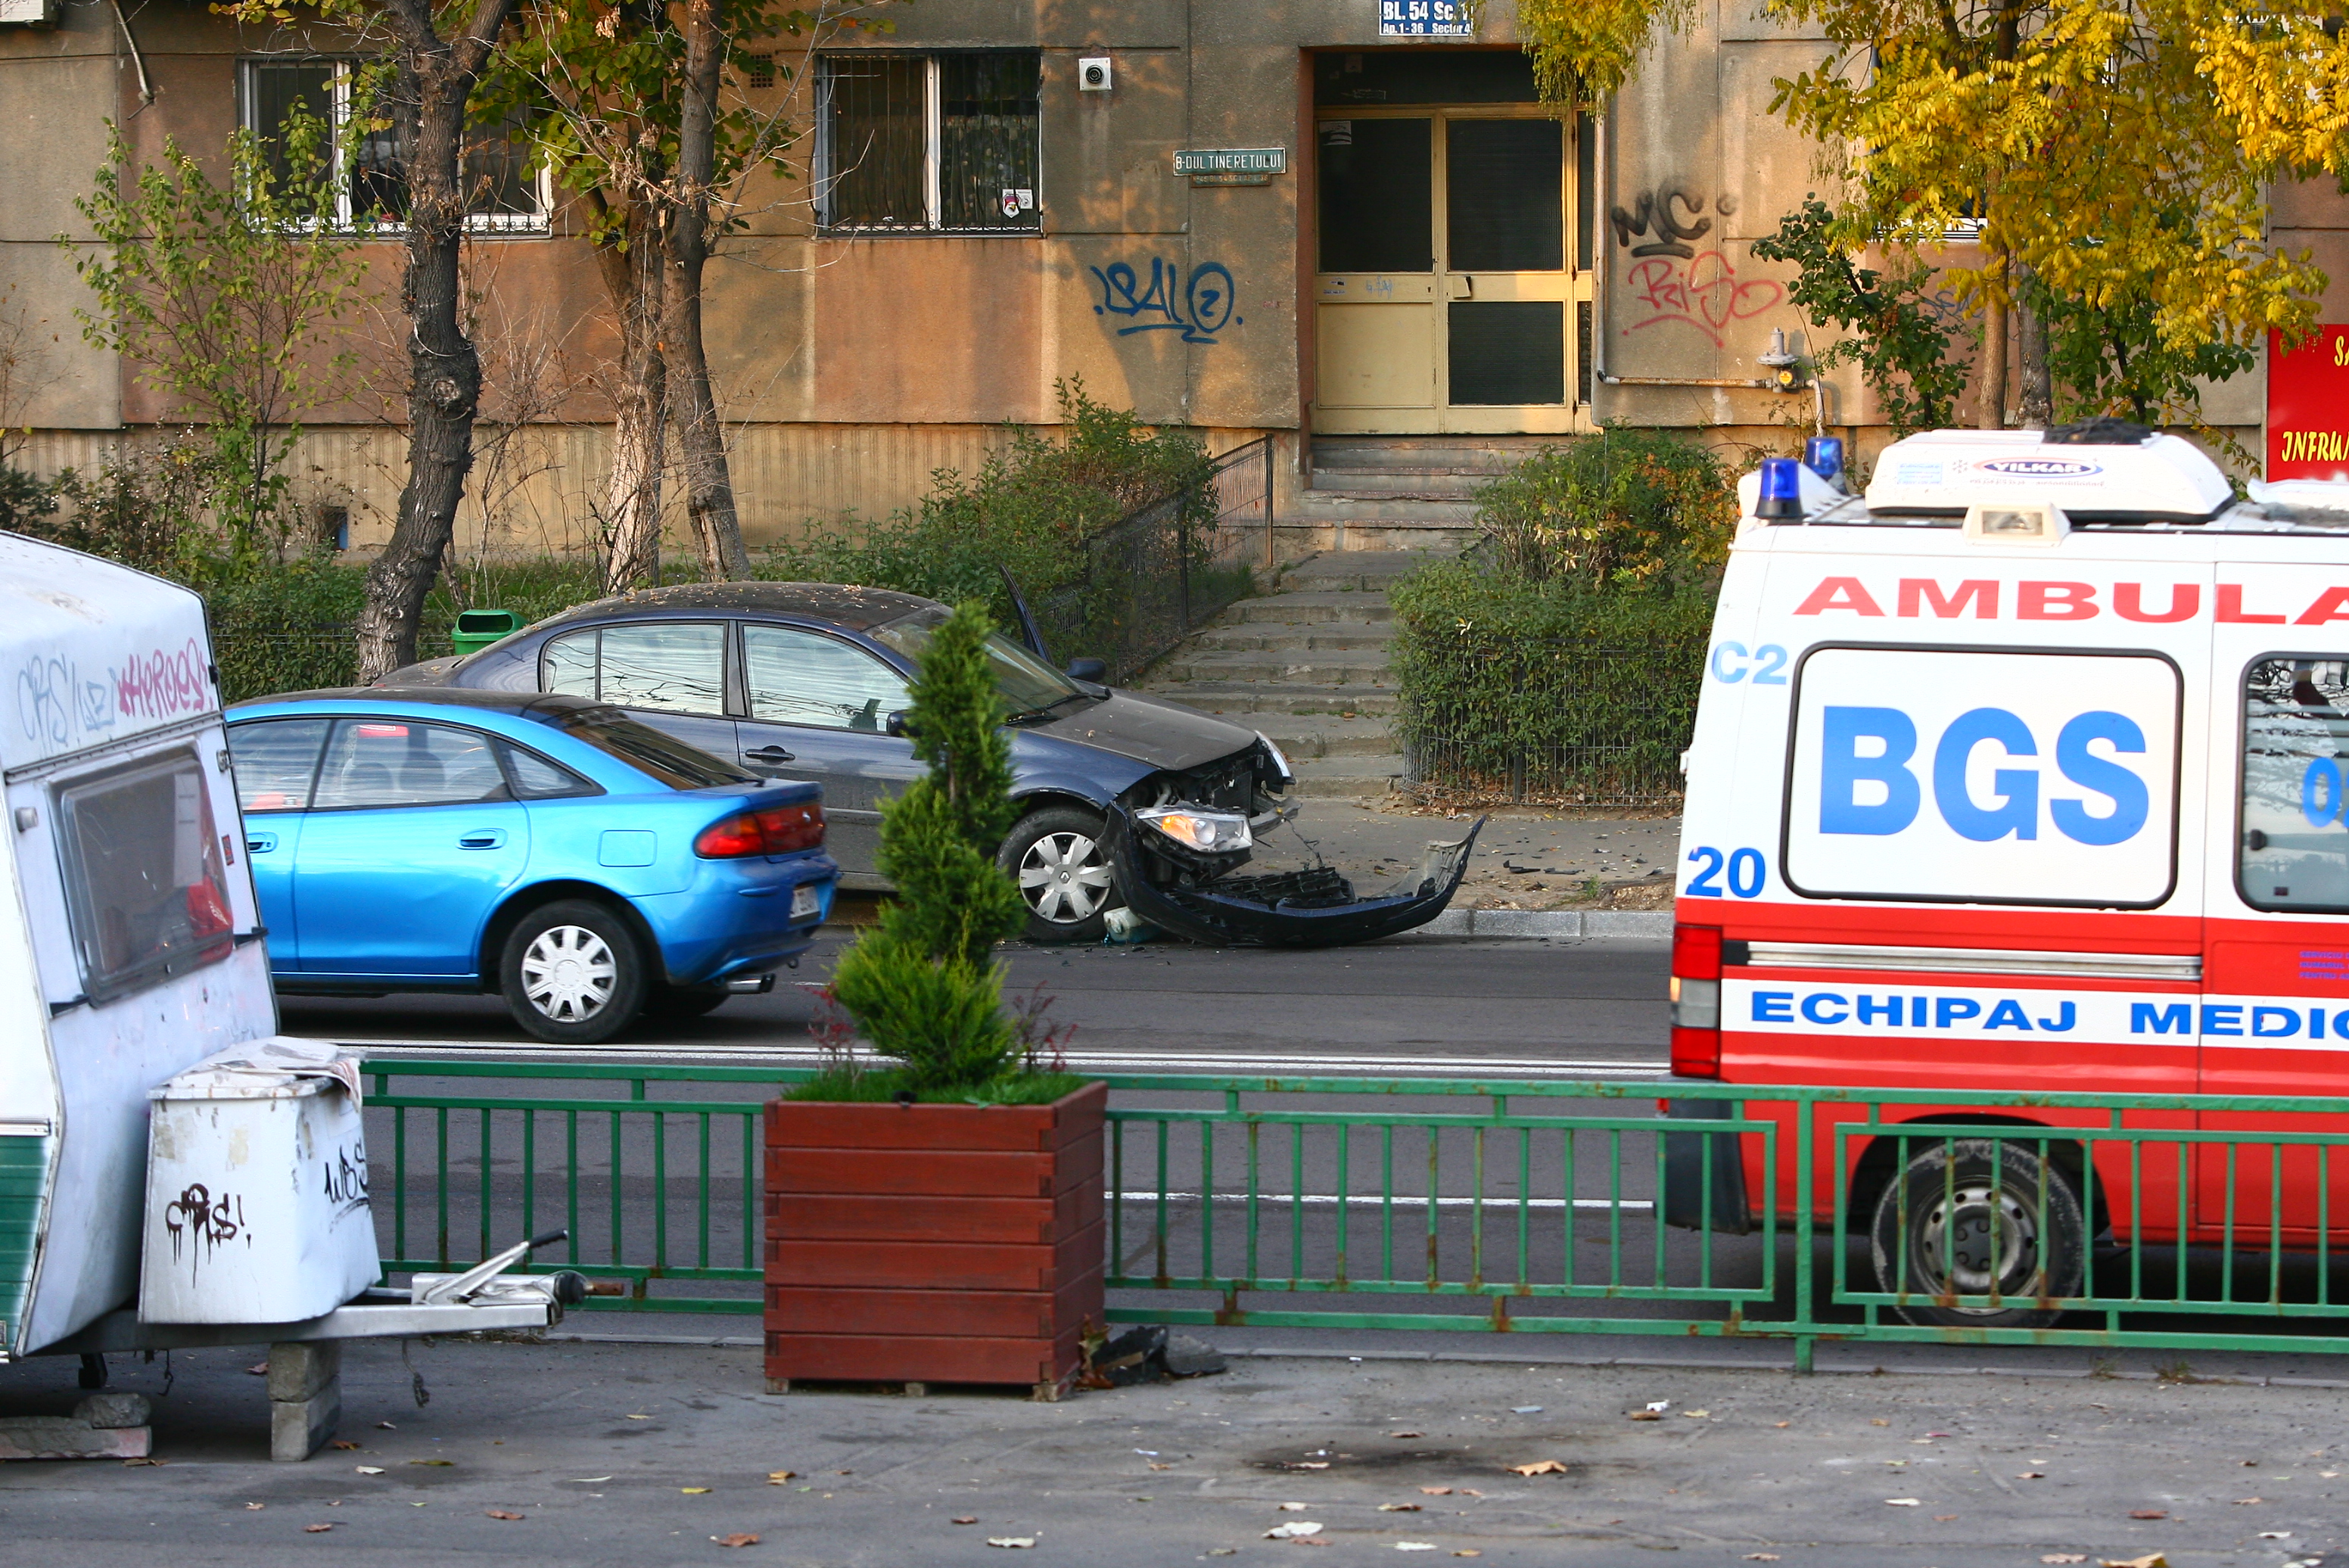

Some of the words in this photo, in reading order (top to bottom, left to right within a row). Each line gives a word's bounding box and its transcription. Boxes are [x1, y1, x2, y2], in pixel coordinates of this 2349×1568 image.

[1383, 1, 1406, 20] BL.
[1409, 1, 1429, 20] 54
[1411, 23, 1424, 33] 36
[1432, 23, 1463, 33] Sector
[1464, 23, 1471, 33] 4
[1175, 155, 1206, 170] B-DUL
[1209, 154, 1281, 169] TINERETULUI
[1711, 641, 1788, 686] C2
[1819, 705, 2149, 846] BGS
[1685, 846, 1766, 899] 20
[1751, 991, 2077, 1033] ECHIPAJ
